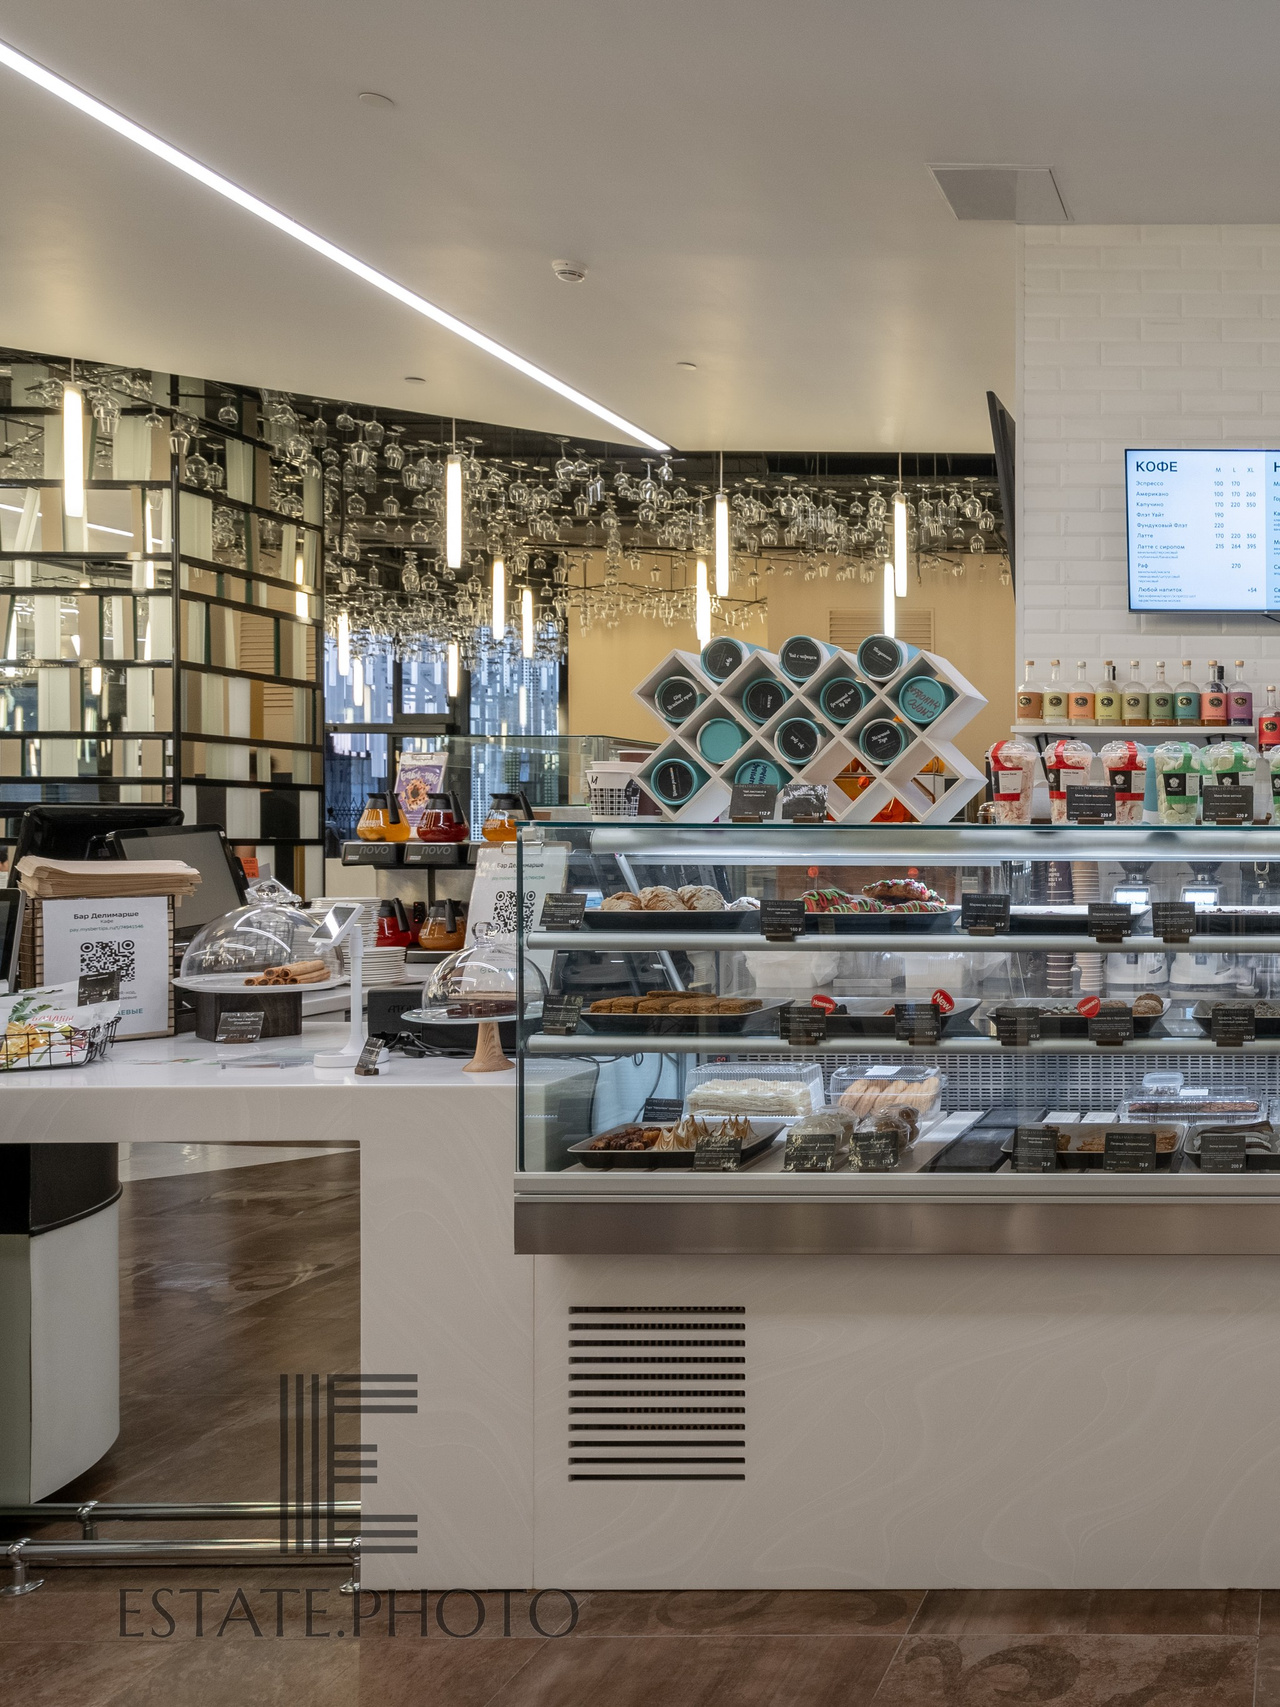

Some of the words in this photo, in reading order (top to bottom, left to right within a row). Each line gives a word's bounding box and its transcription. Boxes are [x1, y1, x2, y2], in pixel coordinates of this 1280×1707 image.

[1136, 461, 1178, 472] КОФЕ
[360, 846, 389, 854] novo
[421, 846, 451, 854] novo
[91, 912, 139, 920] Делимарше
[813, 1000, 833, 1008] Новинка
[934, 992, 951, 1010] New
[1080, 1000, 1099, 1012] Новинка
